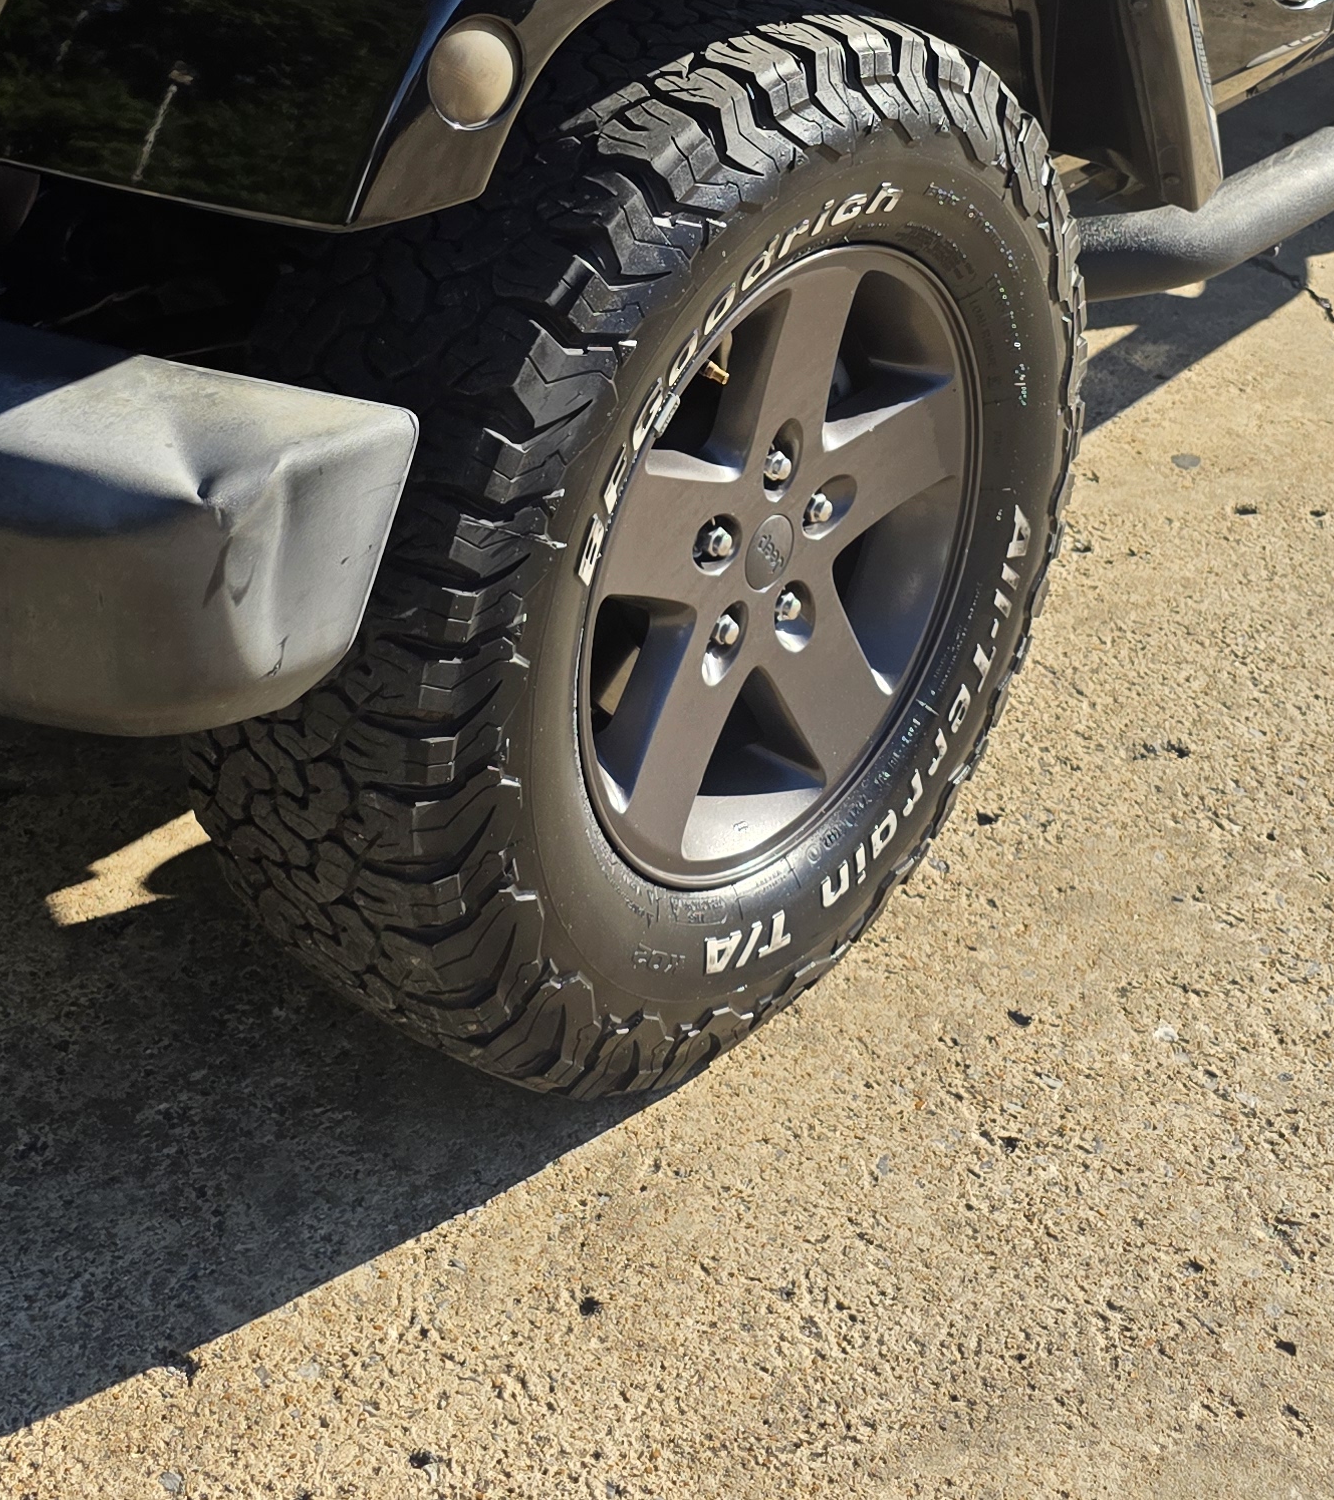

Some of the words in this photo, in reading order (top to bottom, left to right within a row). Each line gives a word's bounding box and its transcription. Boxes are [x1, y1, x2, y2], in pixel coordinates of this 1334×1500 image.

[578, 181, 904, 587] BFGoodrich
[756, 534, 785, 574] Jeep
[820, 503, 1031, 909] All-Terrain
[704, 909, 792, 975] T/A
